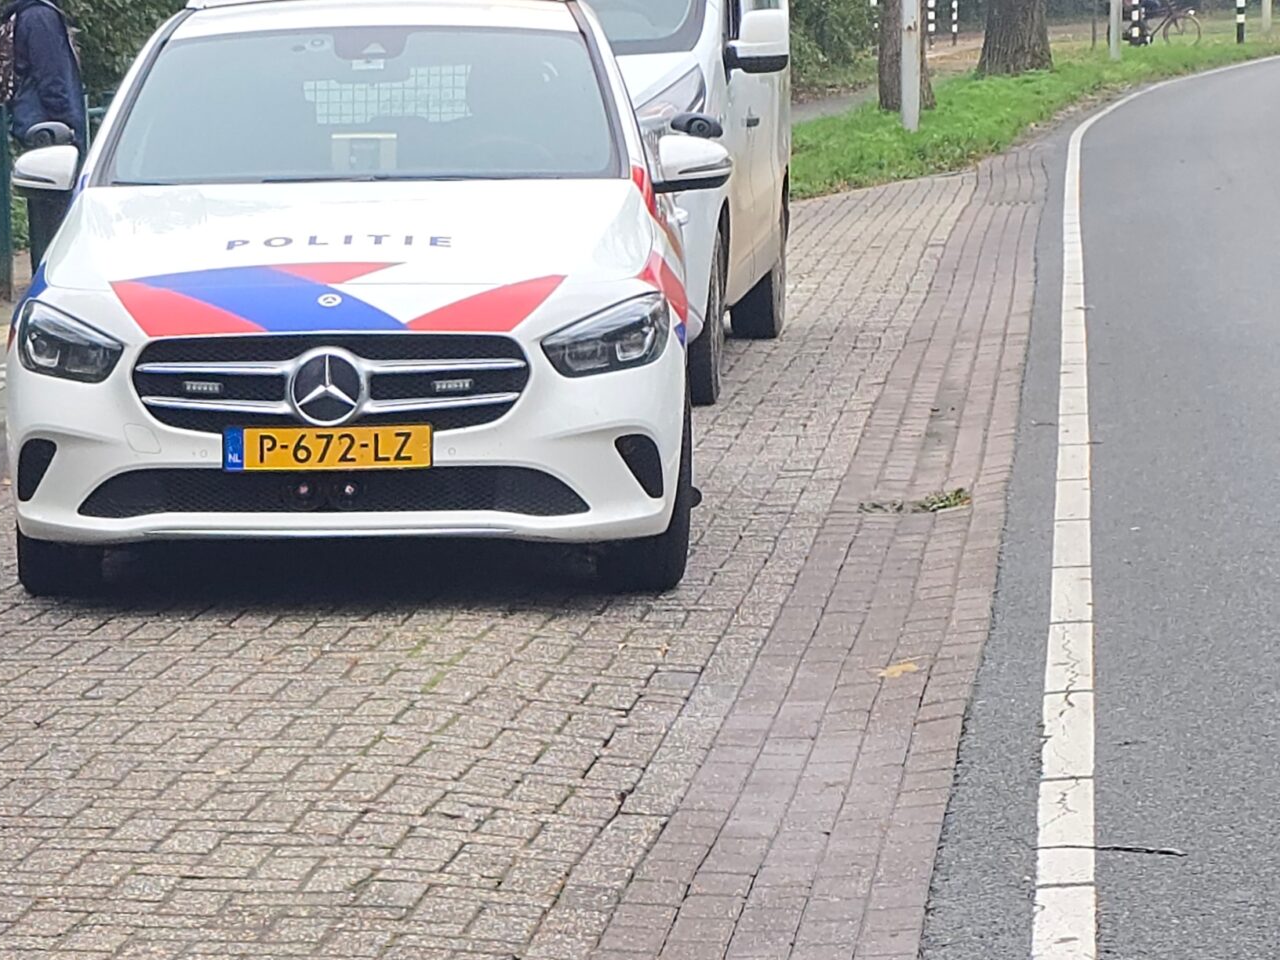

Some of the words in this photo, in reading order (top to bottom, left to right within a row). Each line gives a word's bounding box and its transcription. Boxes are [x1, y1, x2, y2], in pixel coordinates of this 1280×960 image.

[226, 234, 452, 250] POLITIE
[259, 432, 412, 463] P-672-LZ
[228, 453, 241, 463] NL
